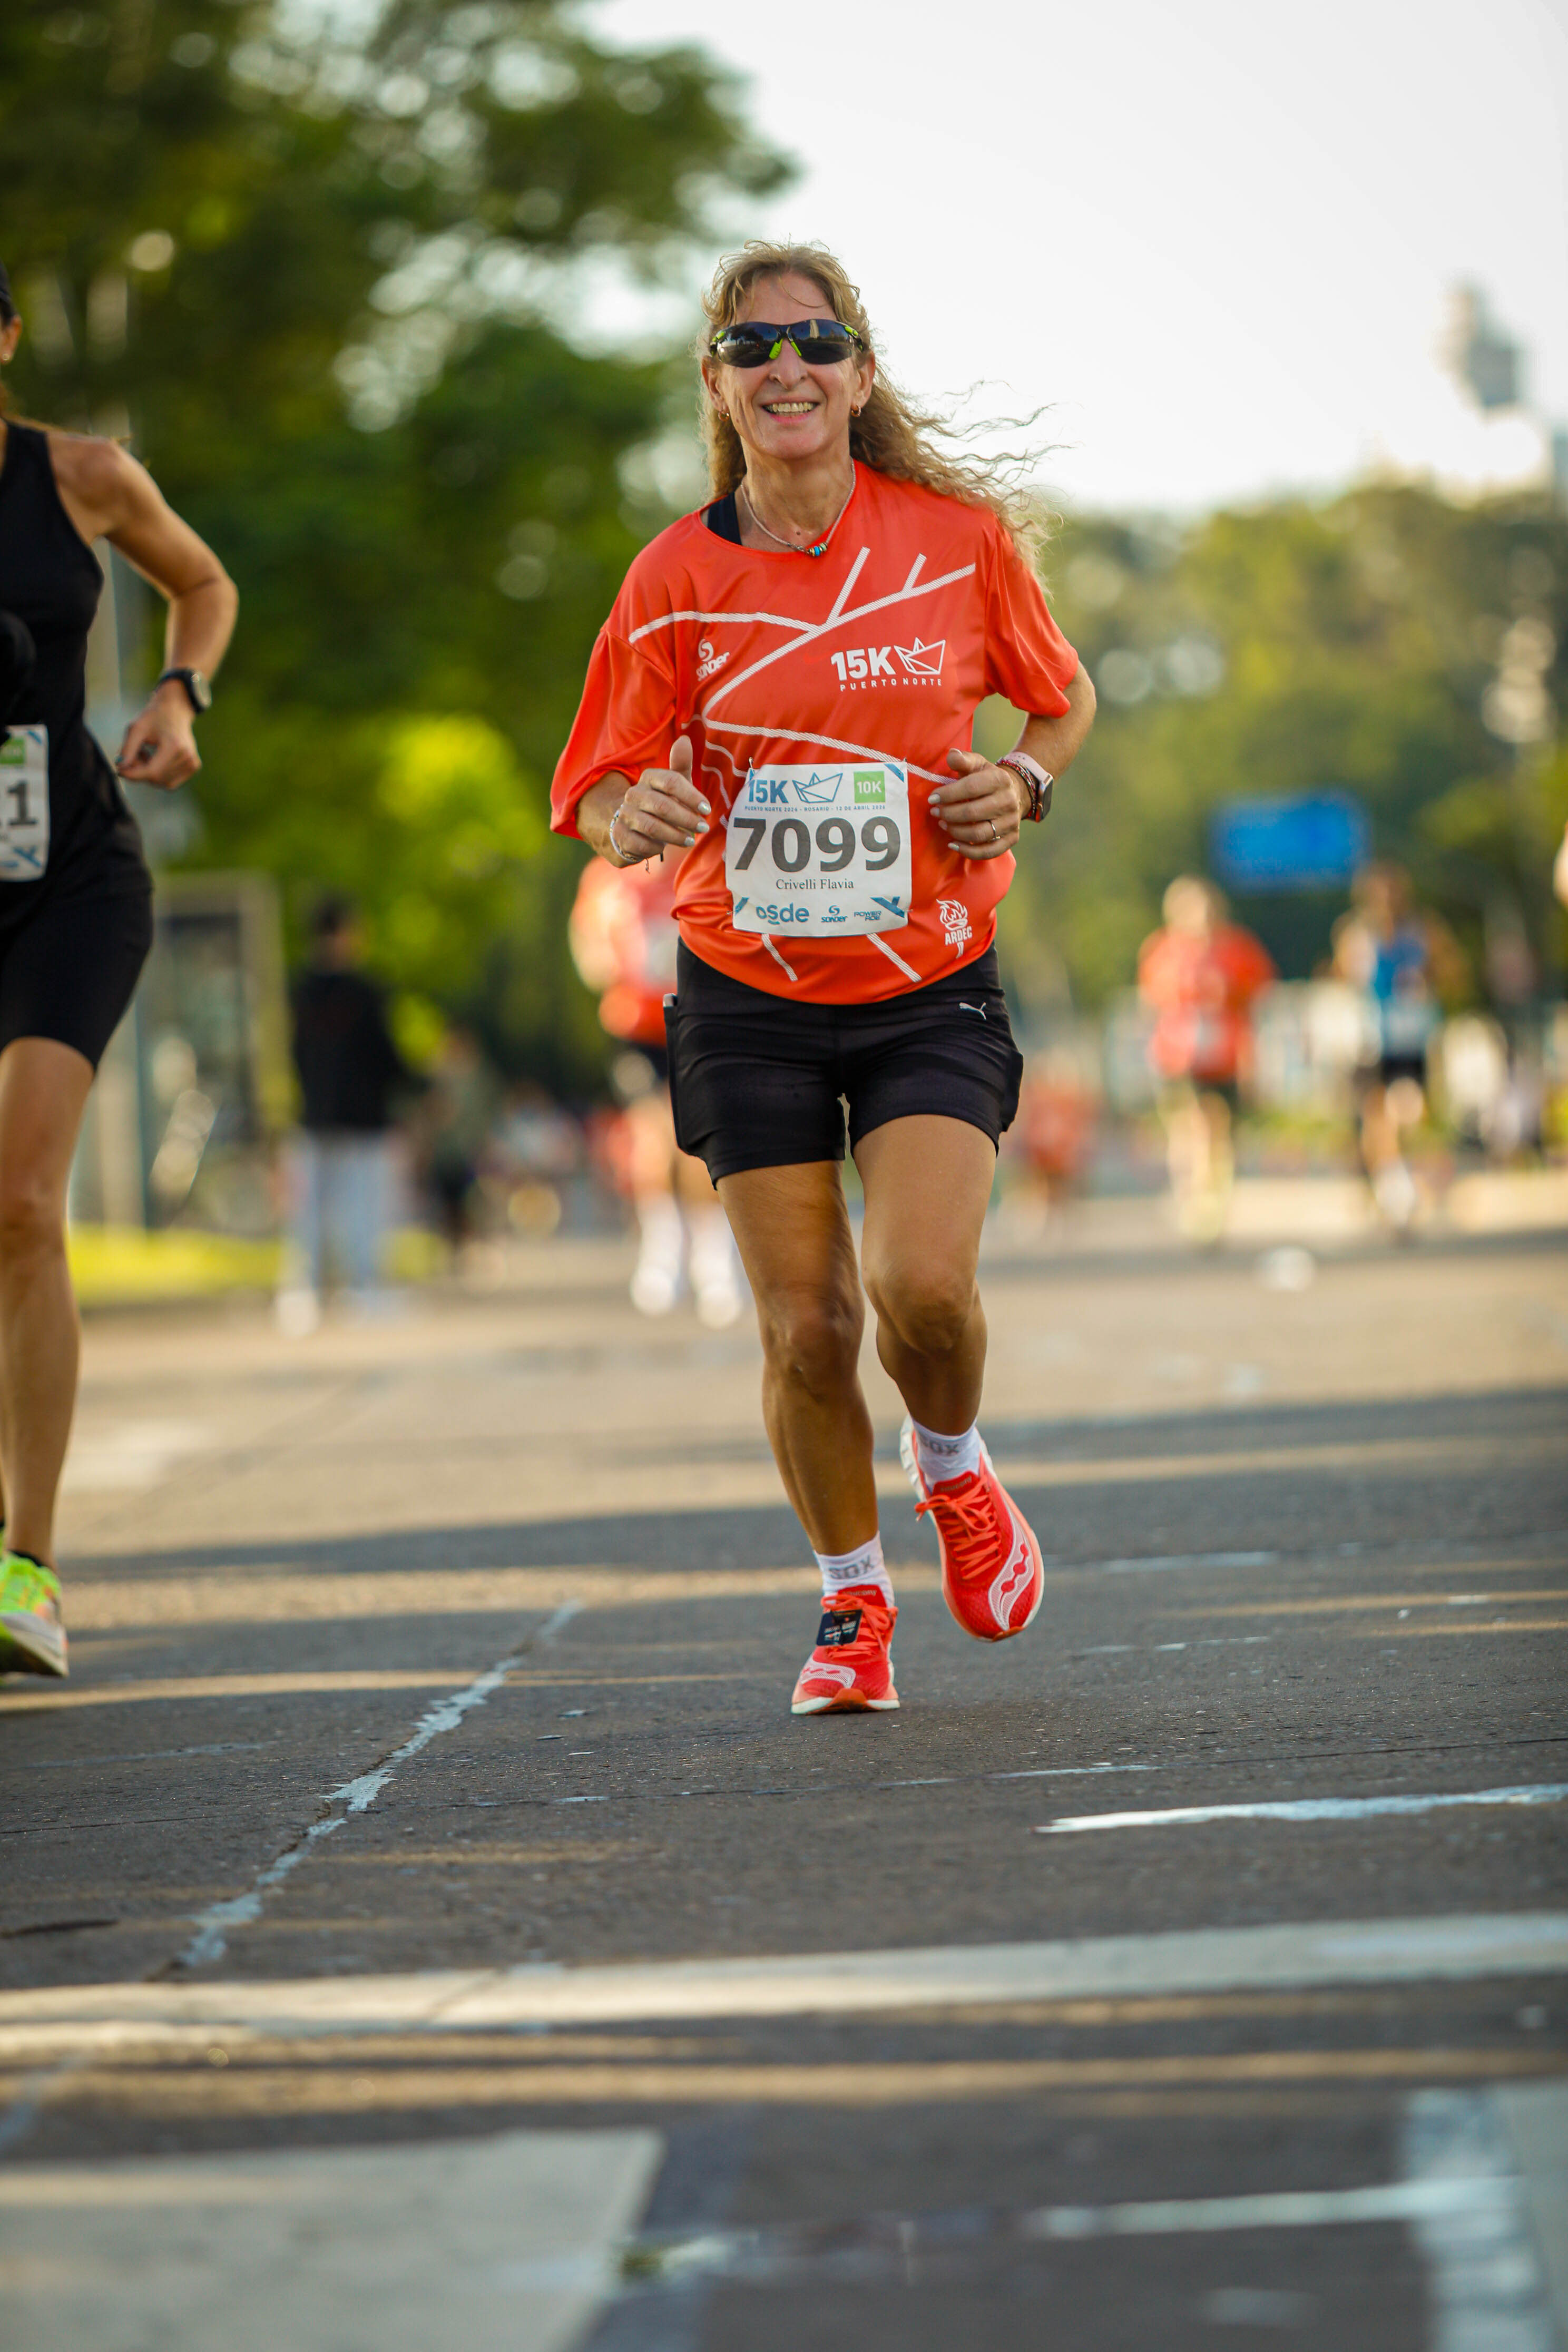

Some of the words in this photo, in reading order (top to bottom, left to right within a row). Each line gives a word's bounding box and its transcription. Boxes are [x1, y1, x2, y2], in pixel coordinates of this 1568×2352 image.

[831, 646, 896, 681] 15K
[840, 678, 897, 691] PUERTO
[903, 677, 942, 686] NORTE
[749, 779, 789, 803] 15K
[857, 780, 883, 794] 10K
[733, 816, 901, 873] 7099
[776, 878, 816, 889] Crivelli
[820, 878, 855, 889] Flavia
[756, 901, 810, 925] osde
[945, 926, 973, 946] ARDEC
